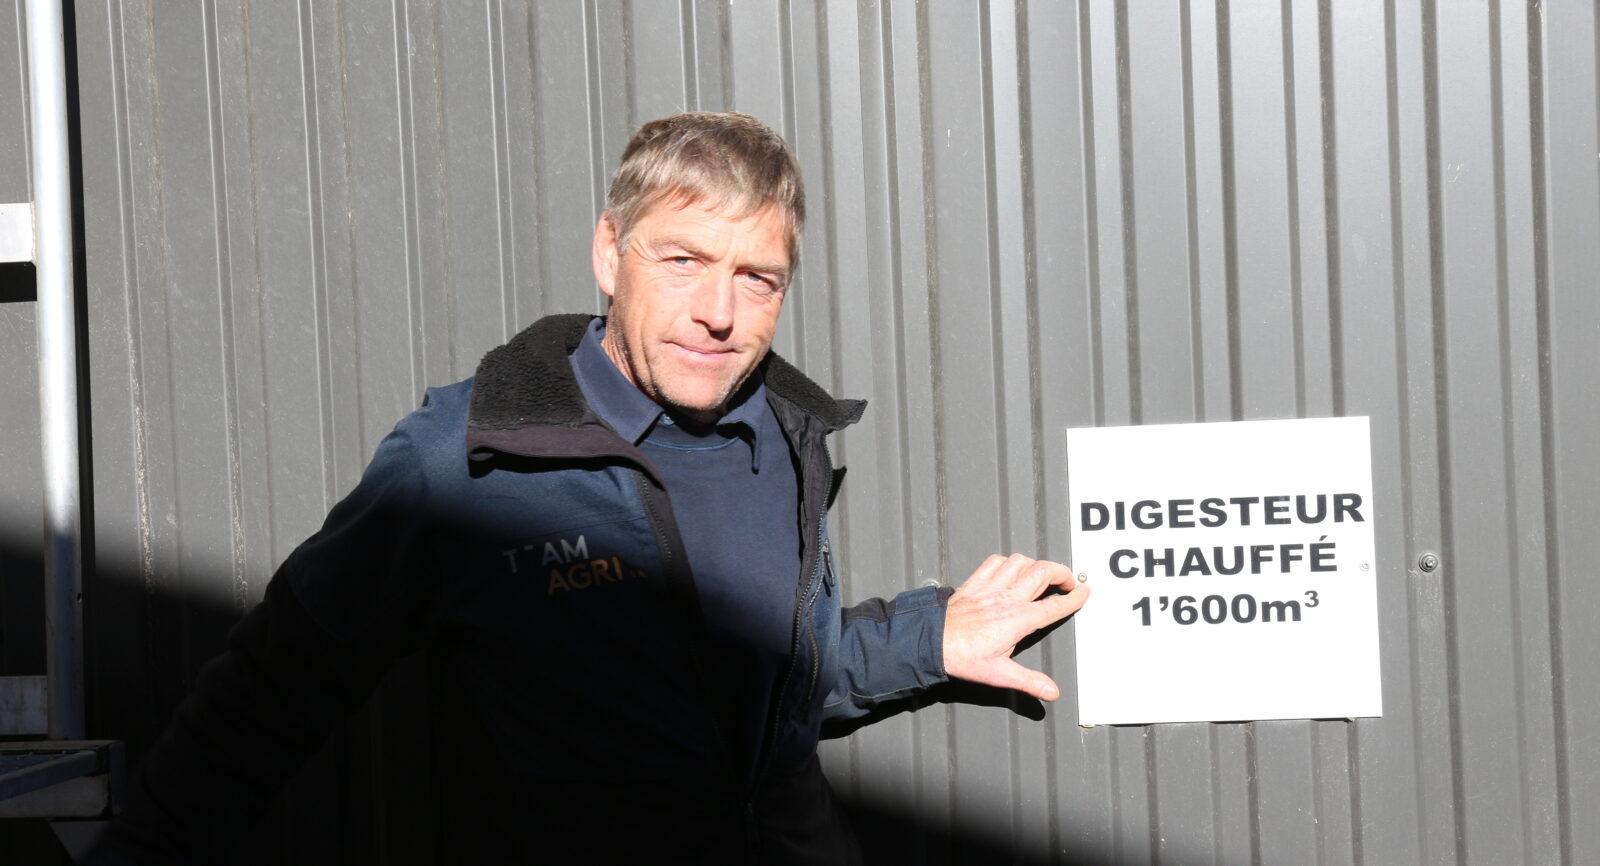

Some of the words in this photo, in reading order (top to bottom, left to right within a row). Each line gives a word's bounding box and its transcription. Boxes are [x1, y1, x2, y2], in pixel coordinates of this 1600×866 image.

[1080, 492, 1365, 531] DIGESTEUR
[501, 534, 590, 574] TAM
[1108, 535, 1338, 579] CHAUFFÉ
